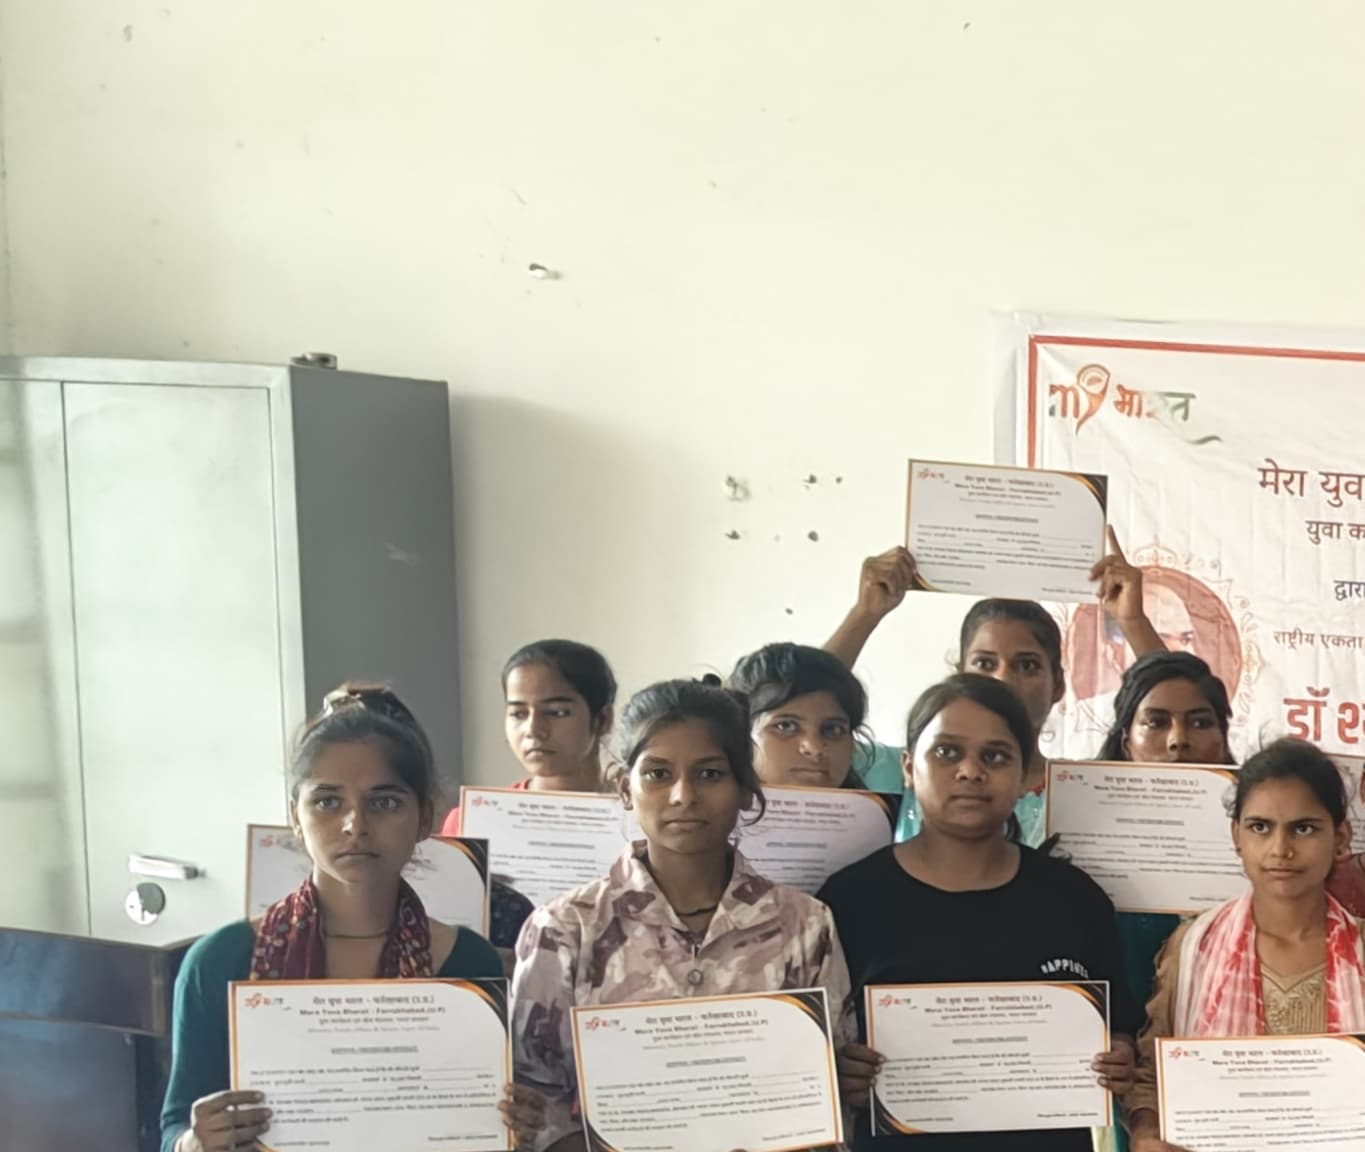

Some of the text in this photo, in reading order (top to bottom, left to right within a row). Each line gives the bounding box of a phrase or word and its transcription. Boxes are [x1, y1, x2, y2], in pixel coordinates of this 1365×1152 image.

[1257, 458, 1308, 497] मेरा
[1305, 520, 1343, 545] युवा
[1273, 627, 1315, 650] राष्ट्रीय
[1320, 633, 1365, 649] एकता
[1283, 686, 1330, 742] डॉ
